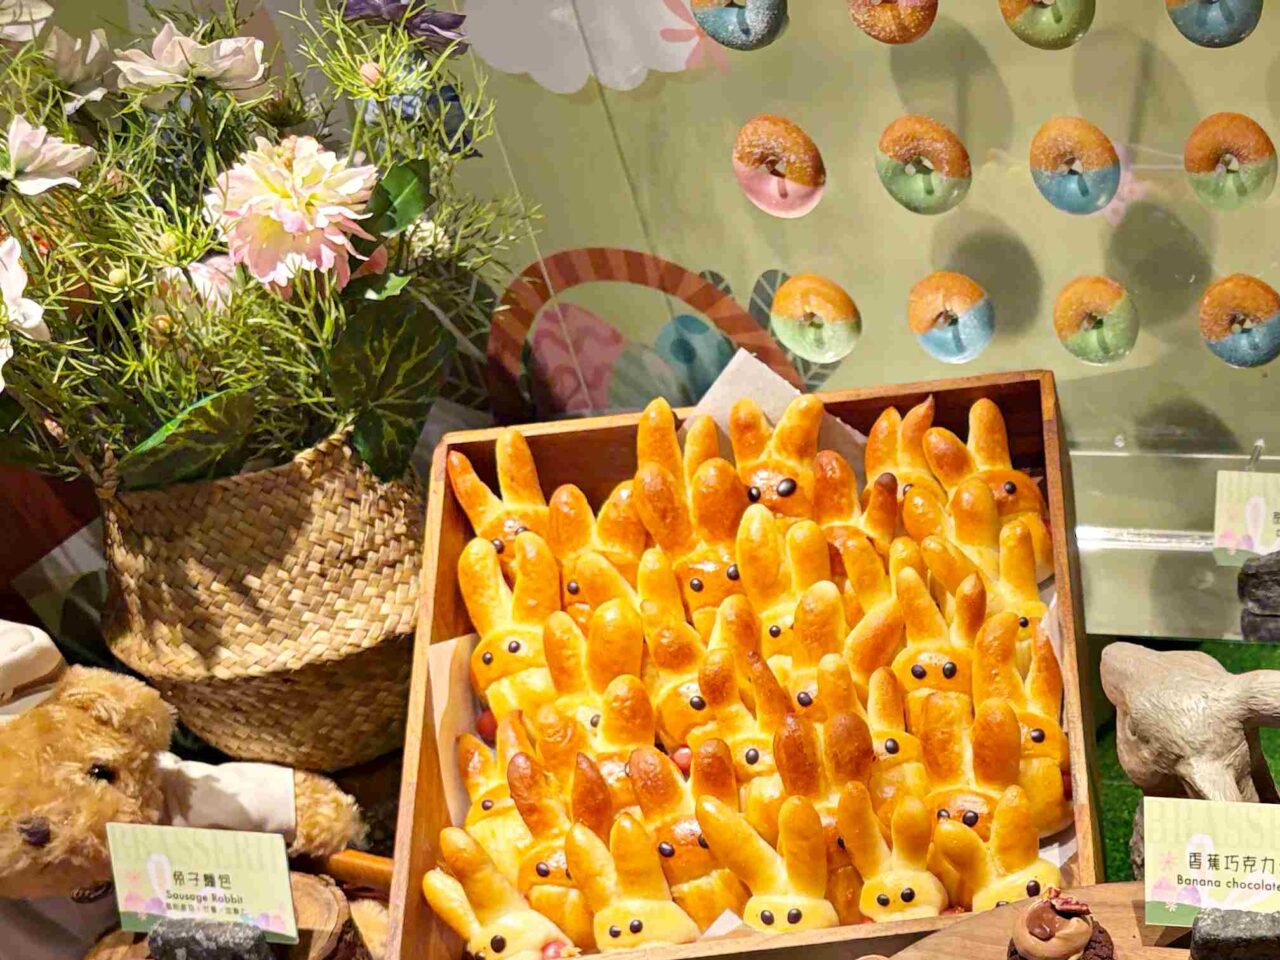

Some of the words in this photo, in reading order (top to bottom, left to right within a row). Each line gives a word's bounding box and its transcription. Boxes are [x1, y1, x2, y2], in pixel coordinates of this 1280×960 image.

[1176, 873, 1222, 888] Banana
[165, 889, 208, 904] Sausage
[212, 893, 243, 905] Rabbit
